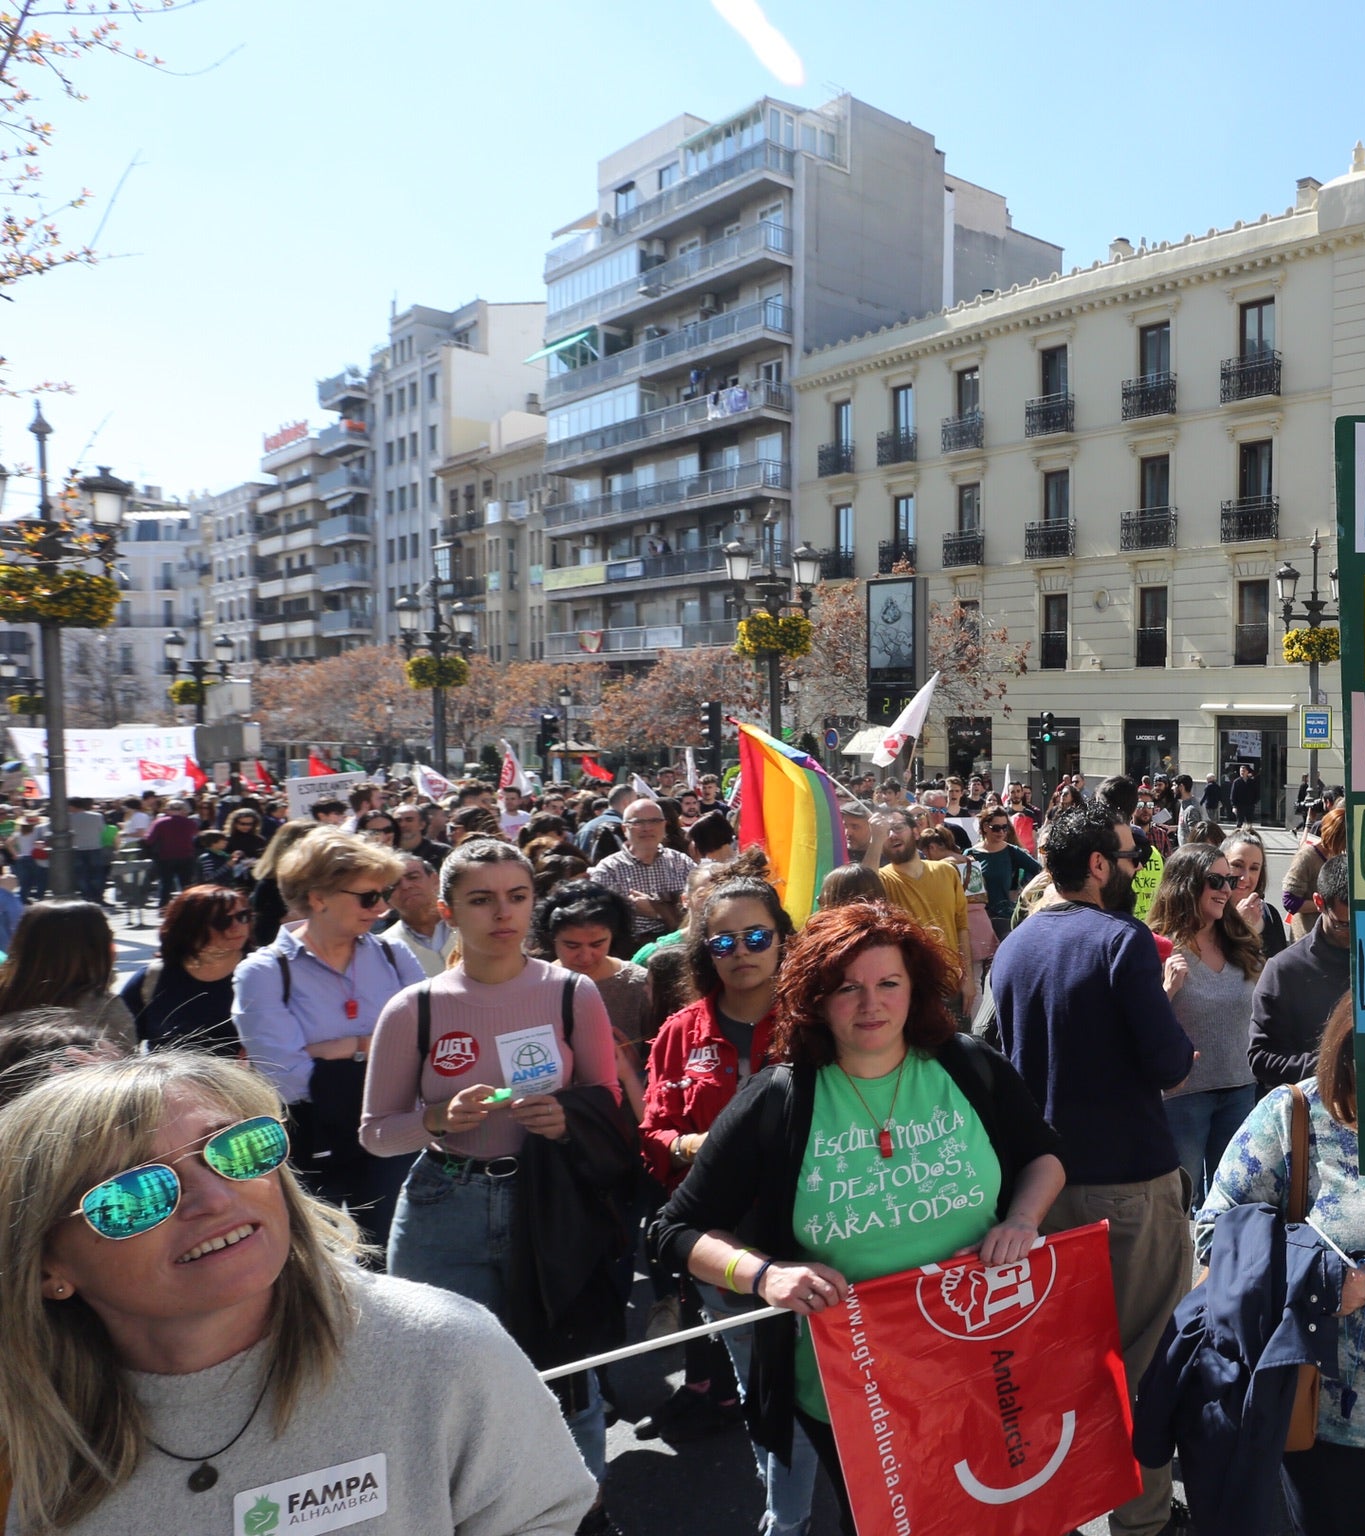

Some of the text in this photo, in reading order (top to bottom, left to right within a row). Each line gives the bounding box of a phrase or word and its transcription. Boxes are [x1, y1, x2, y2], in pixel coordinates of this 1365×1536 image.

[435, 1037, 473, 1058] UGT
[689, 1043, 719, 1061] UGT
[511, 1062, 558, 1083] ANPE
[814, 1110, 965, 1158] ESCUEL PÚBLICA
[828, 1154, 962, 1204] DE TOD@S
[809, 1184, 985, 1245] PARA TOD@S
[984, 1258, 1035, 1318] GT
[992, 1349, 1027, 1469] Andalucía
[288, 1472, 379, 1514] FAMPA
[289, 1492, 379, 1526] ALHAMBRA
